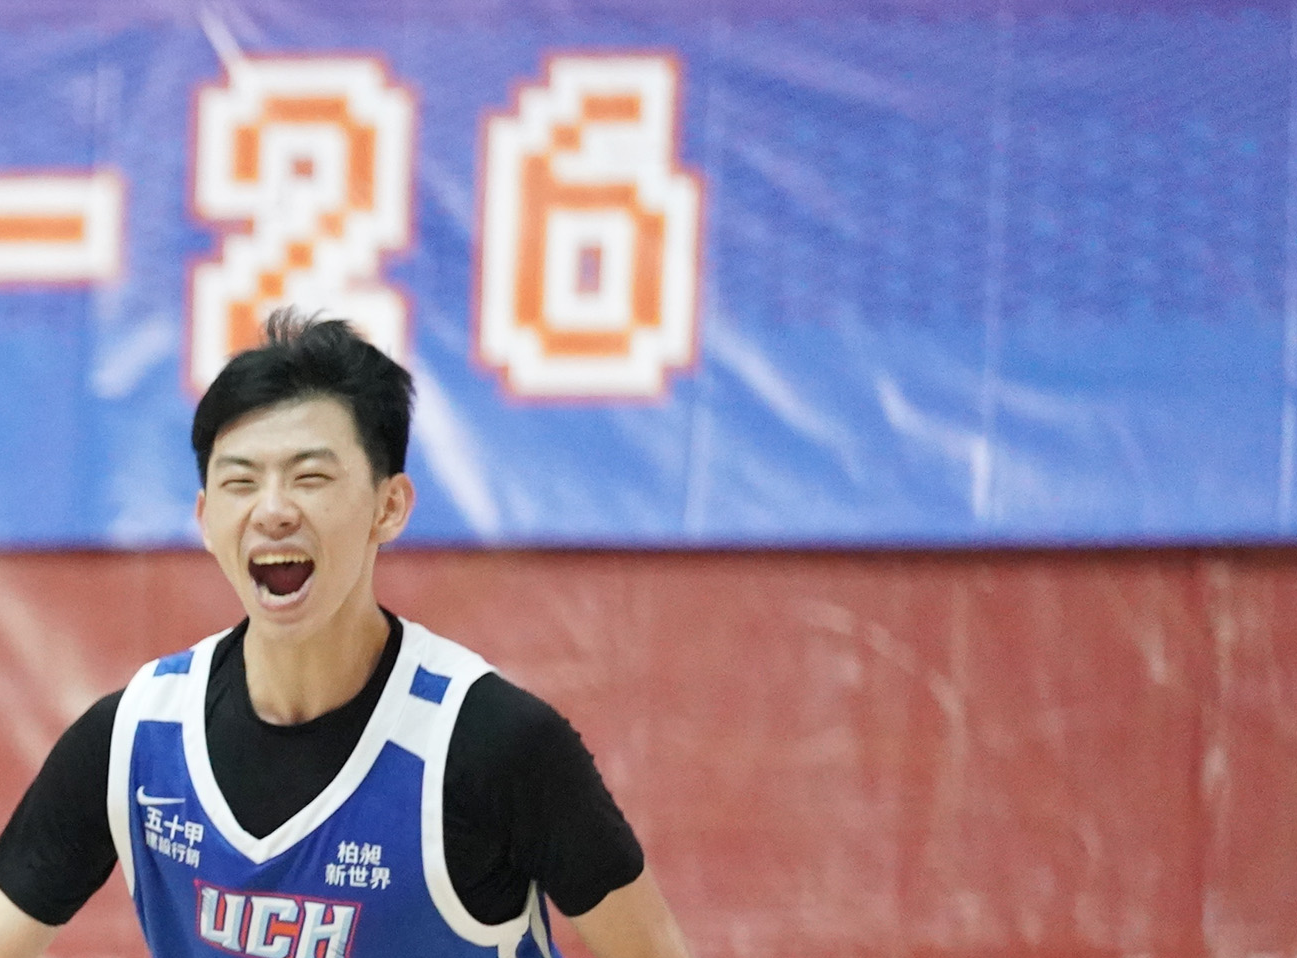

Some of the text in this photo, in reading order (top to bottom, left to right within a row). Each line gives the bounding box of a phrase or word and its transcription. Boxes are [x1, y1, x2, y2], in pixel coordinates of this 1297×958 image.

[144, 806, 204, 847] 五十甲
[325, 863, 391, 890] 新世界
